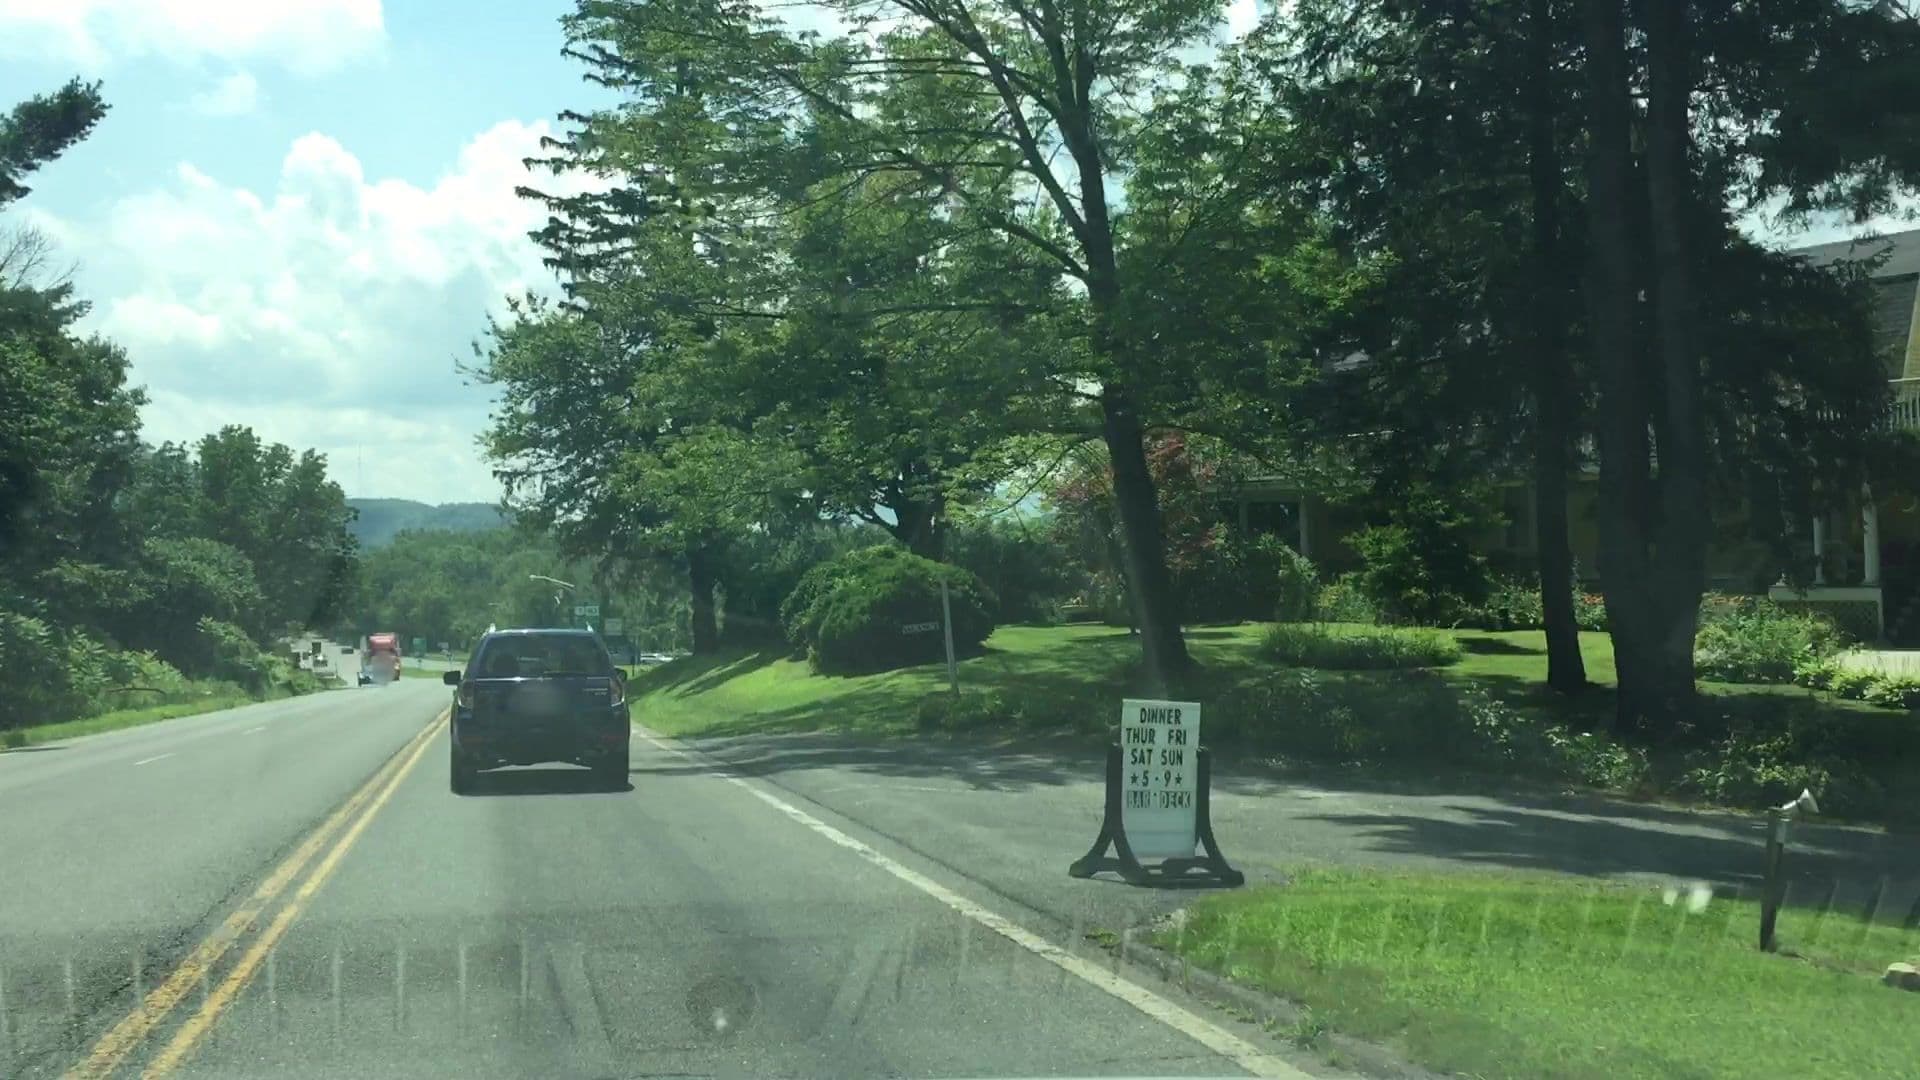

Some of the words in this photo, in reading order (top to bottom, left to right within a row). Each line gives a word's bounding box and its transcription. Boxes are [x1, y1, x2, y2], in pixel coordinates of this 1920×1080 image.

[1139, 707, 1182, 725] DINNER
[1126, 727, 1156, 745] THUR
[1167, 728, 1187, 745] FRI
[1130, 748, 1153, 766] SAT
[1160, 749, 1183, 766] SUN
[1160, 791, 1191, 809] DECK
